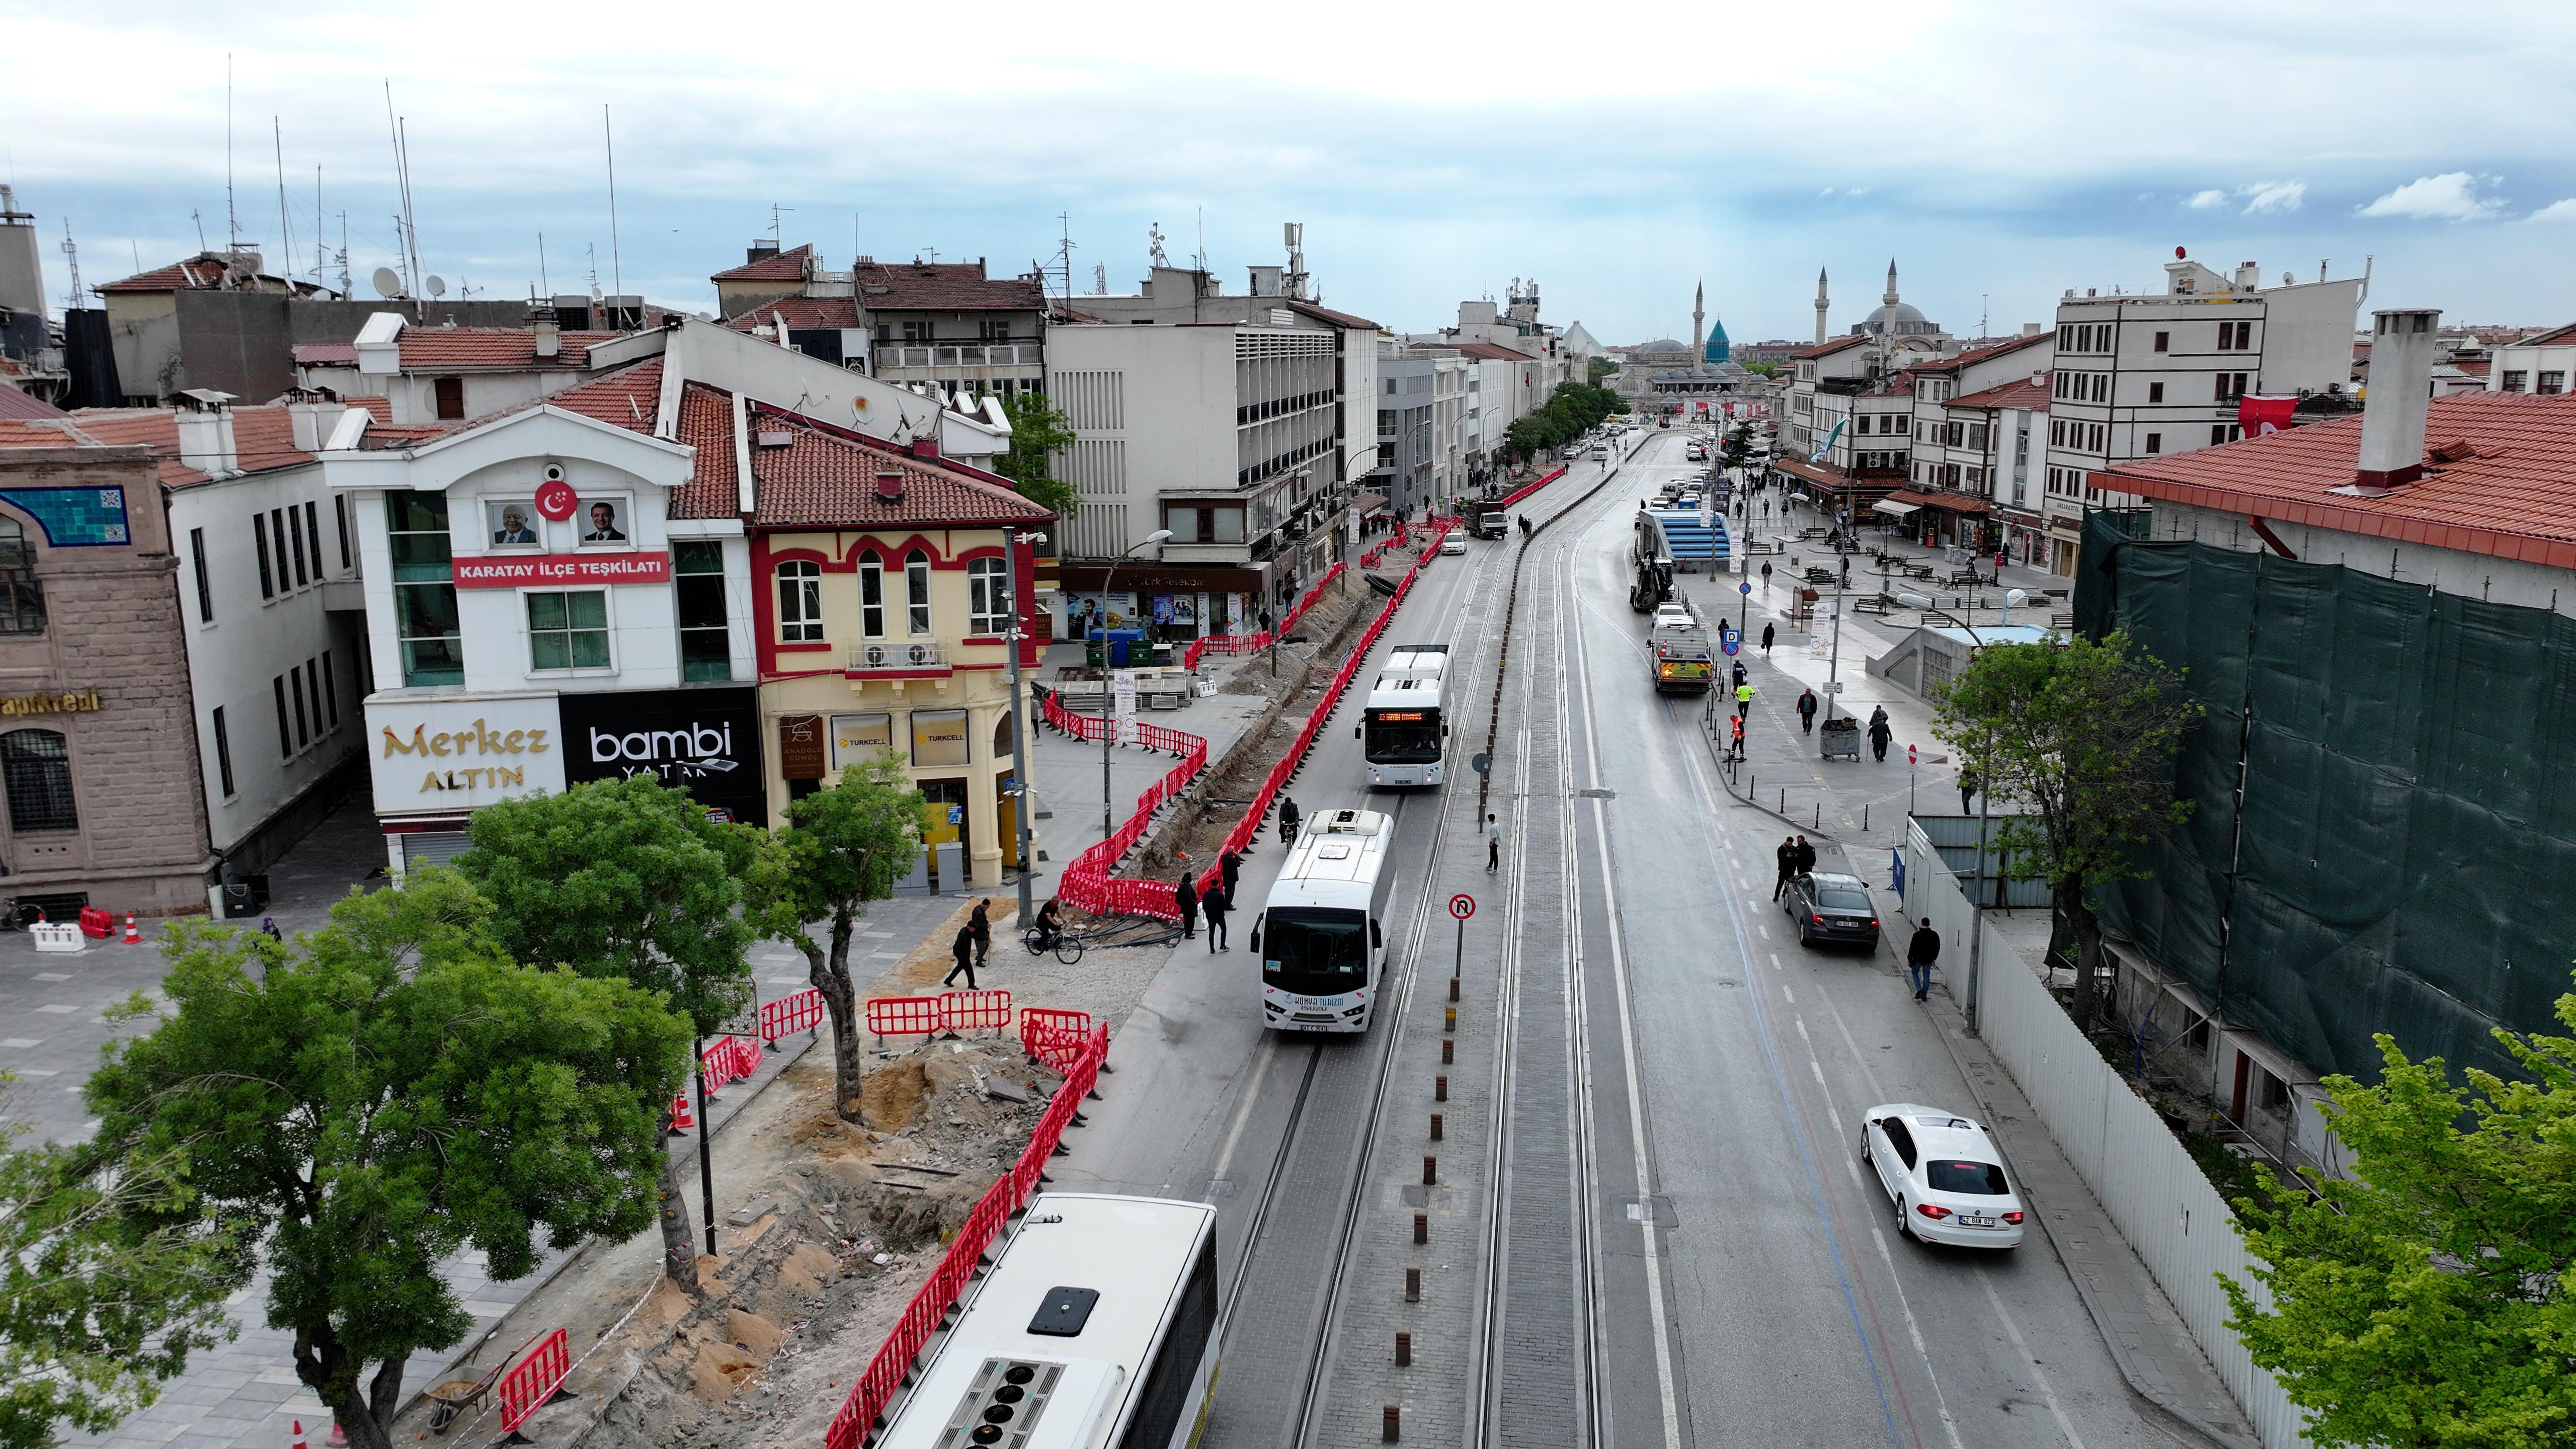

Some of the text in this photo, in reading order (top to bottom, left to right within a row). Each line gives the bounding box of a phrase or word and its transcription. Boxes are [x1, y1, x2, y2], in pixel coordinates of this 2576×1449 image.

[460, 558, 662, 578] KARATAY İLÇE TEŞKİLATI
[1141, 577, 1205, 586] Türk Telekom
[1728, 633, 1735, 641] D
[382, 718, 549, 758] Merkez
[590, 721, 731, 762] bambi
[419, 764, 523, 792] ALTIN
[1295, 997, 1343, 1006] KONYA TURİZM
